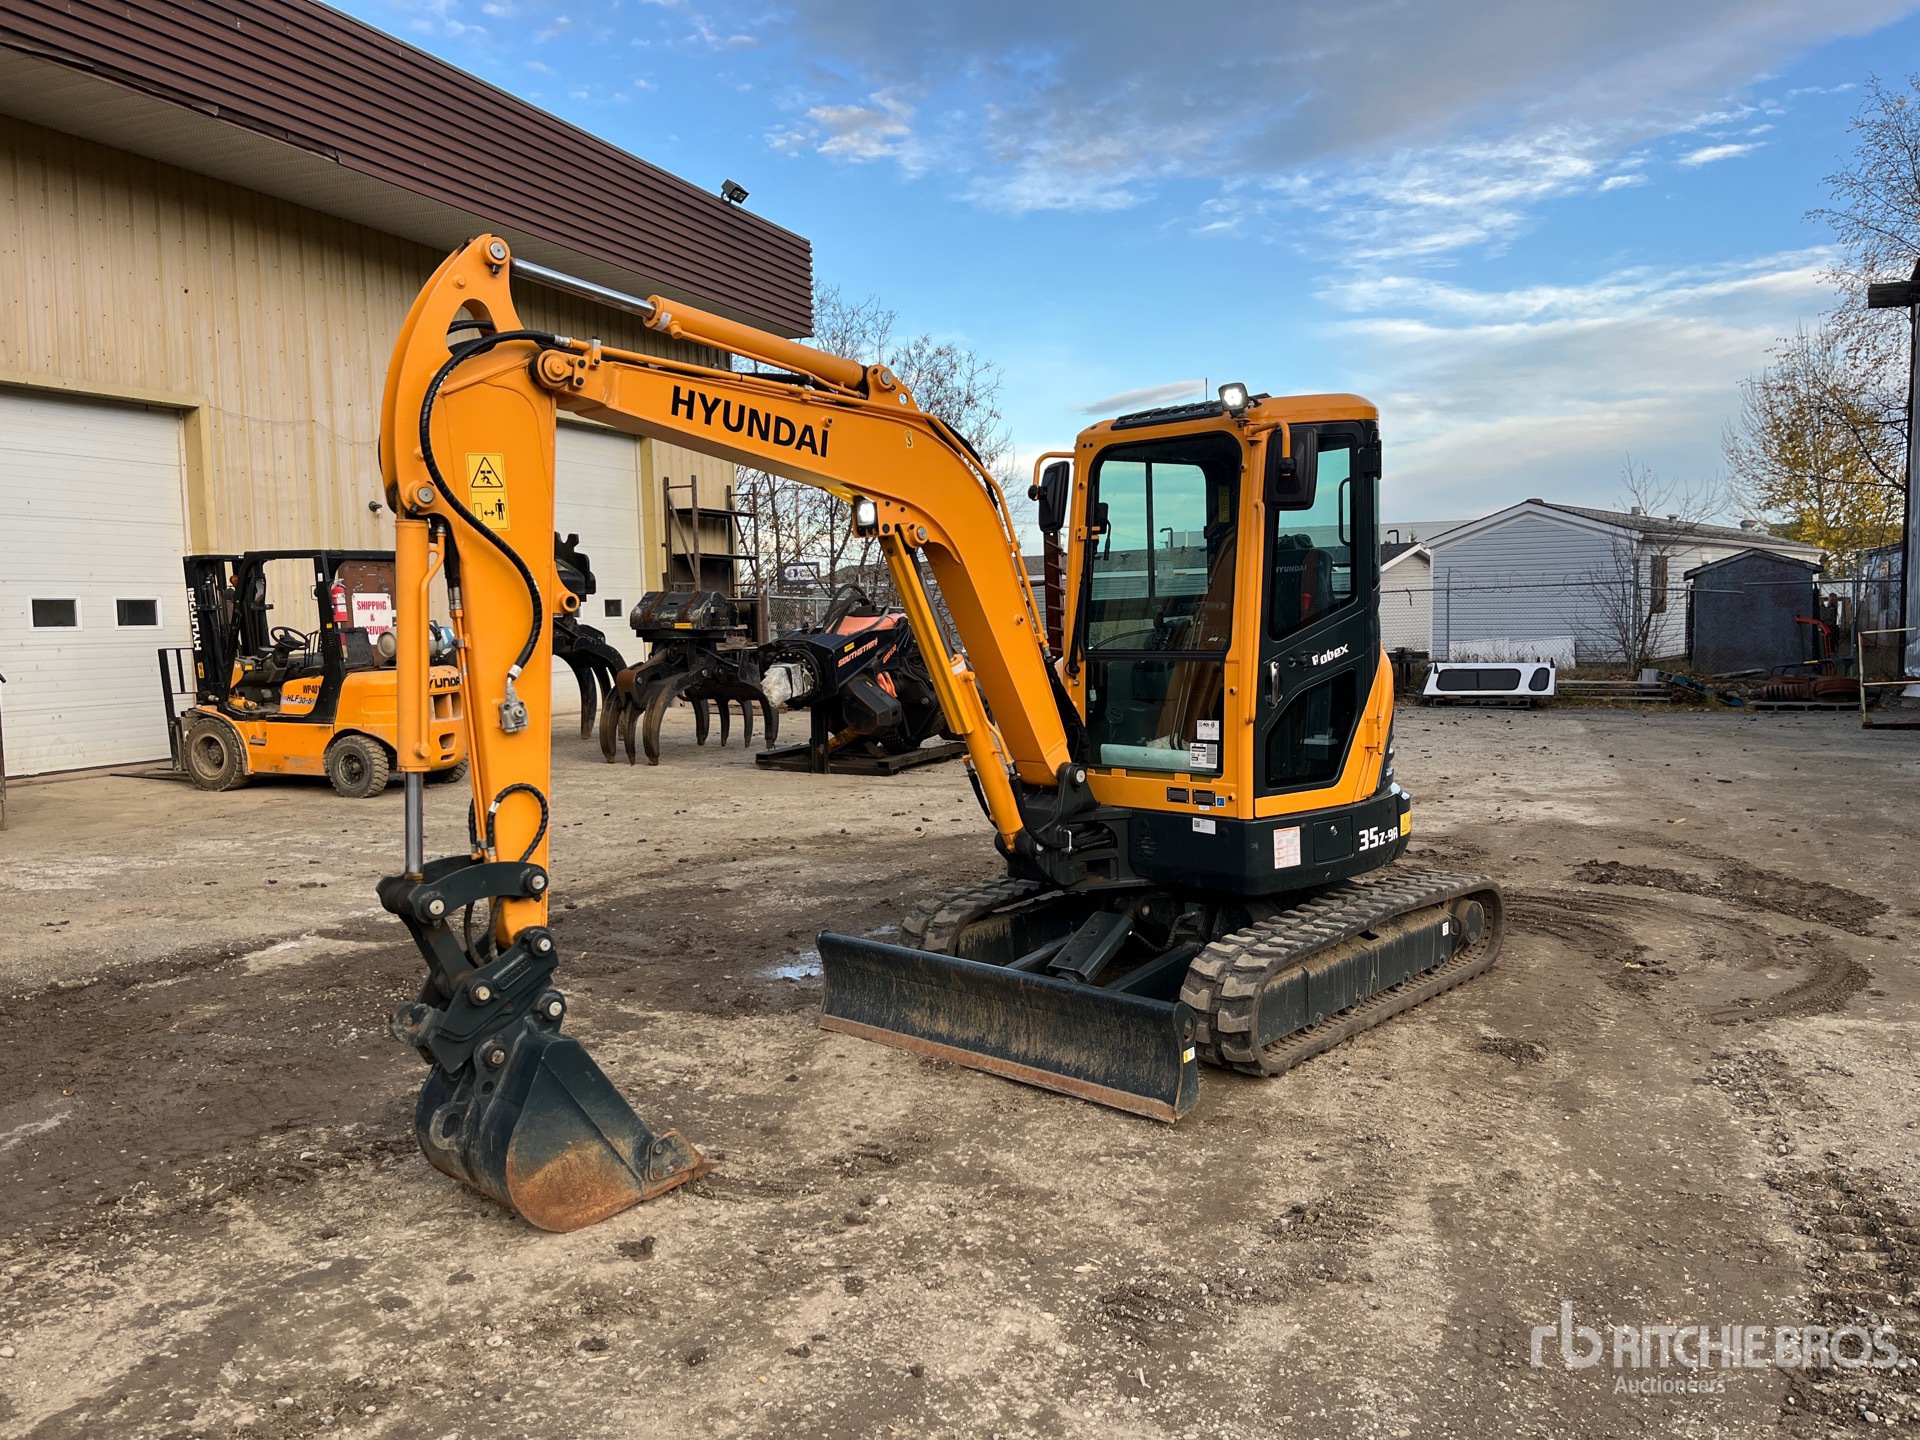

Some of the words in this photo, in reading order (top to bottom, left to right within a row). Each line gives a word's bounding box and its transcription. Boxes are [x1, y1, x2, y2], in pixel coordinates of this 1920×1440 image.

[671, 385, 829, 458] HYUNDAI
[356, 600, 387, 610] SHIPPING
[187, 587, 202, 651] HYUNDAI
[370, 613, 375, 622] &
[1311, 643, 1349, 666] Robex
